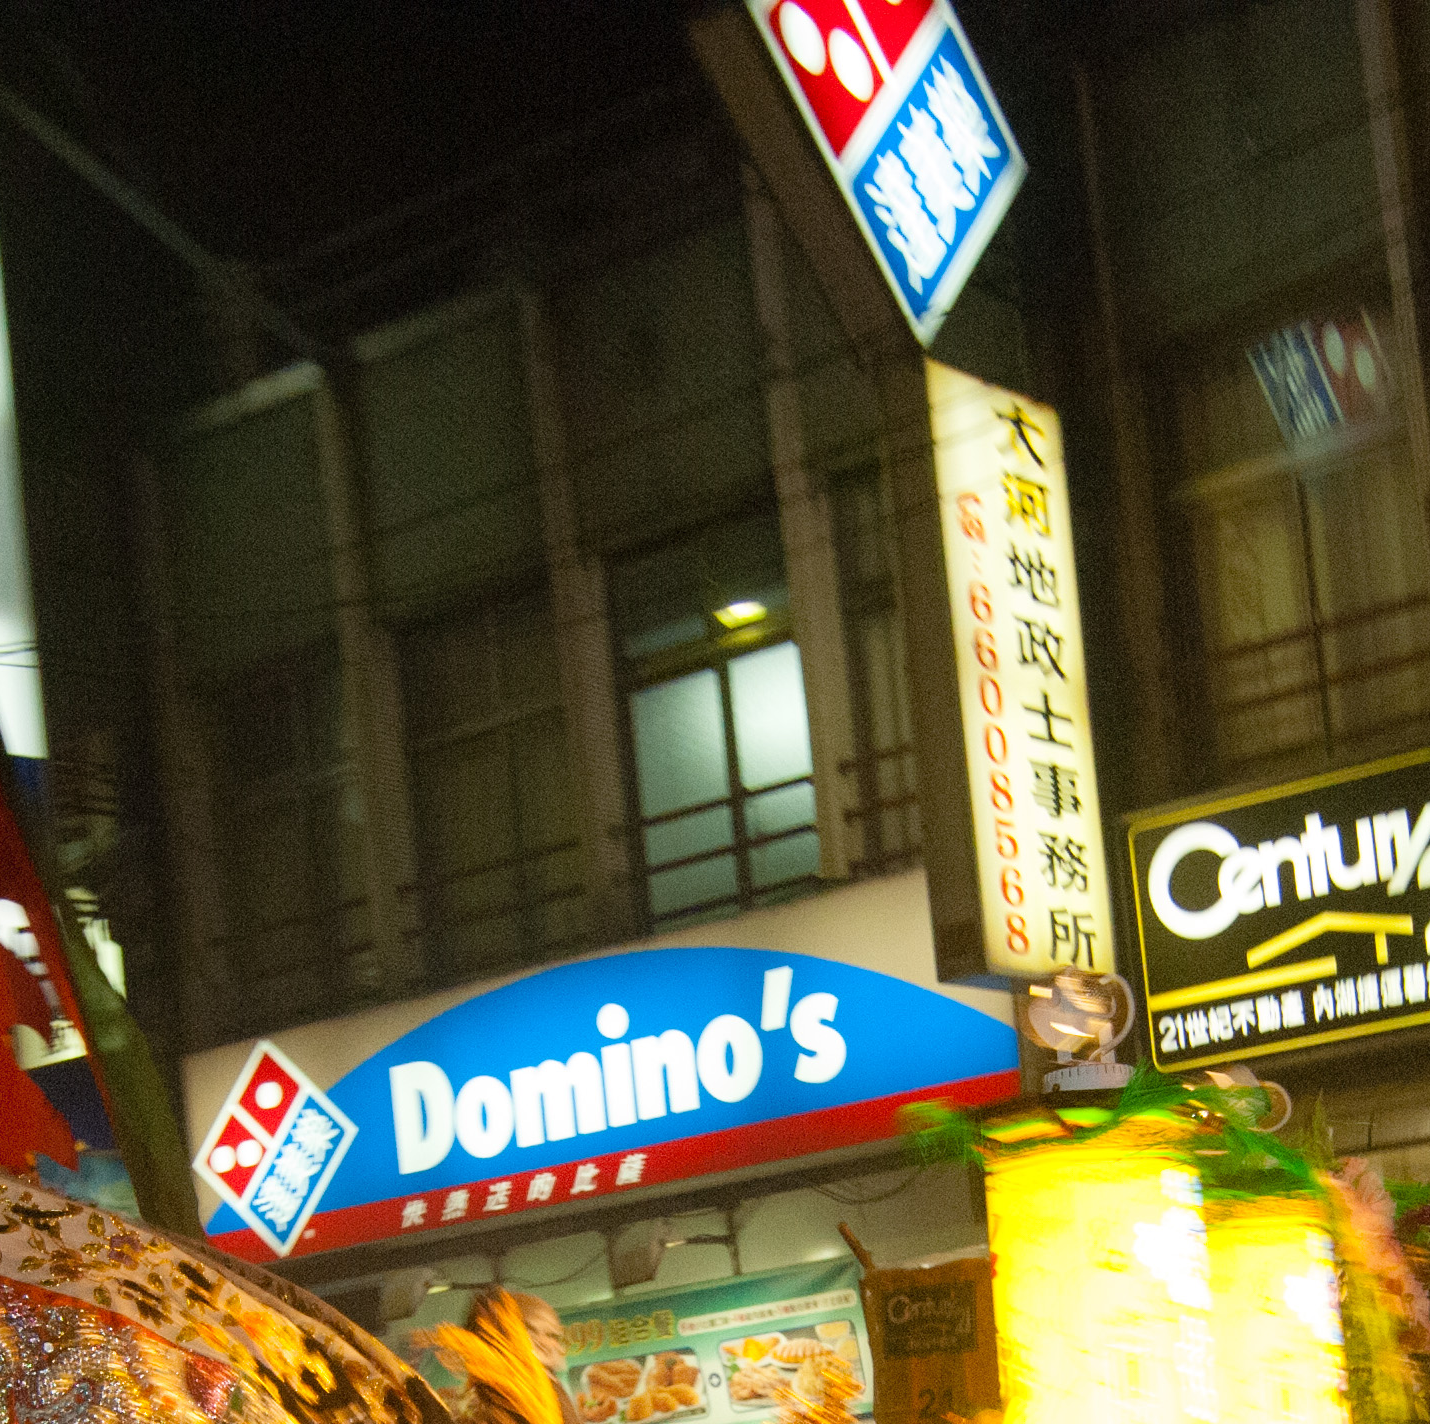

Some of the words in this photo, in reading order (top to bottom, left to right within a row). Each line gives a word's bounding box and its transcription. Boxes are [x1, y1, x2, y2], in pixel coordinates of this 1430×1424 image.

[992, 402, 1096, 968] 大河地政士事務所
[389, 966, 847, 1175] Domino's
[1158, 989, 1307, 1054] 21世紀不動產
